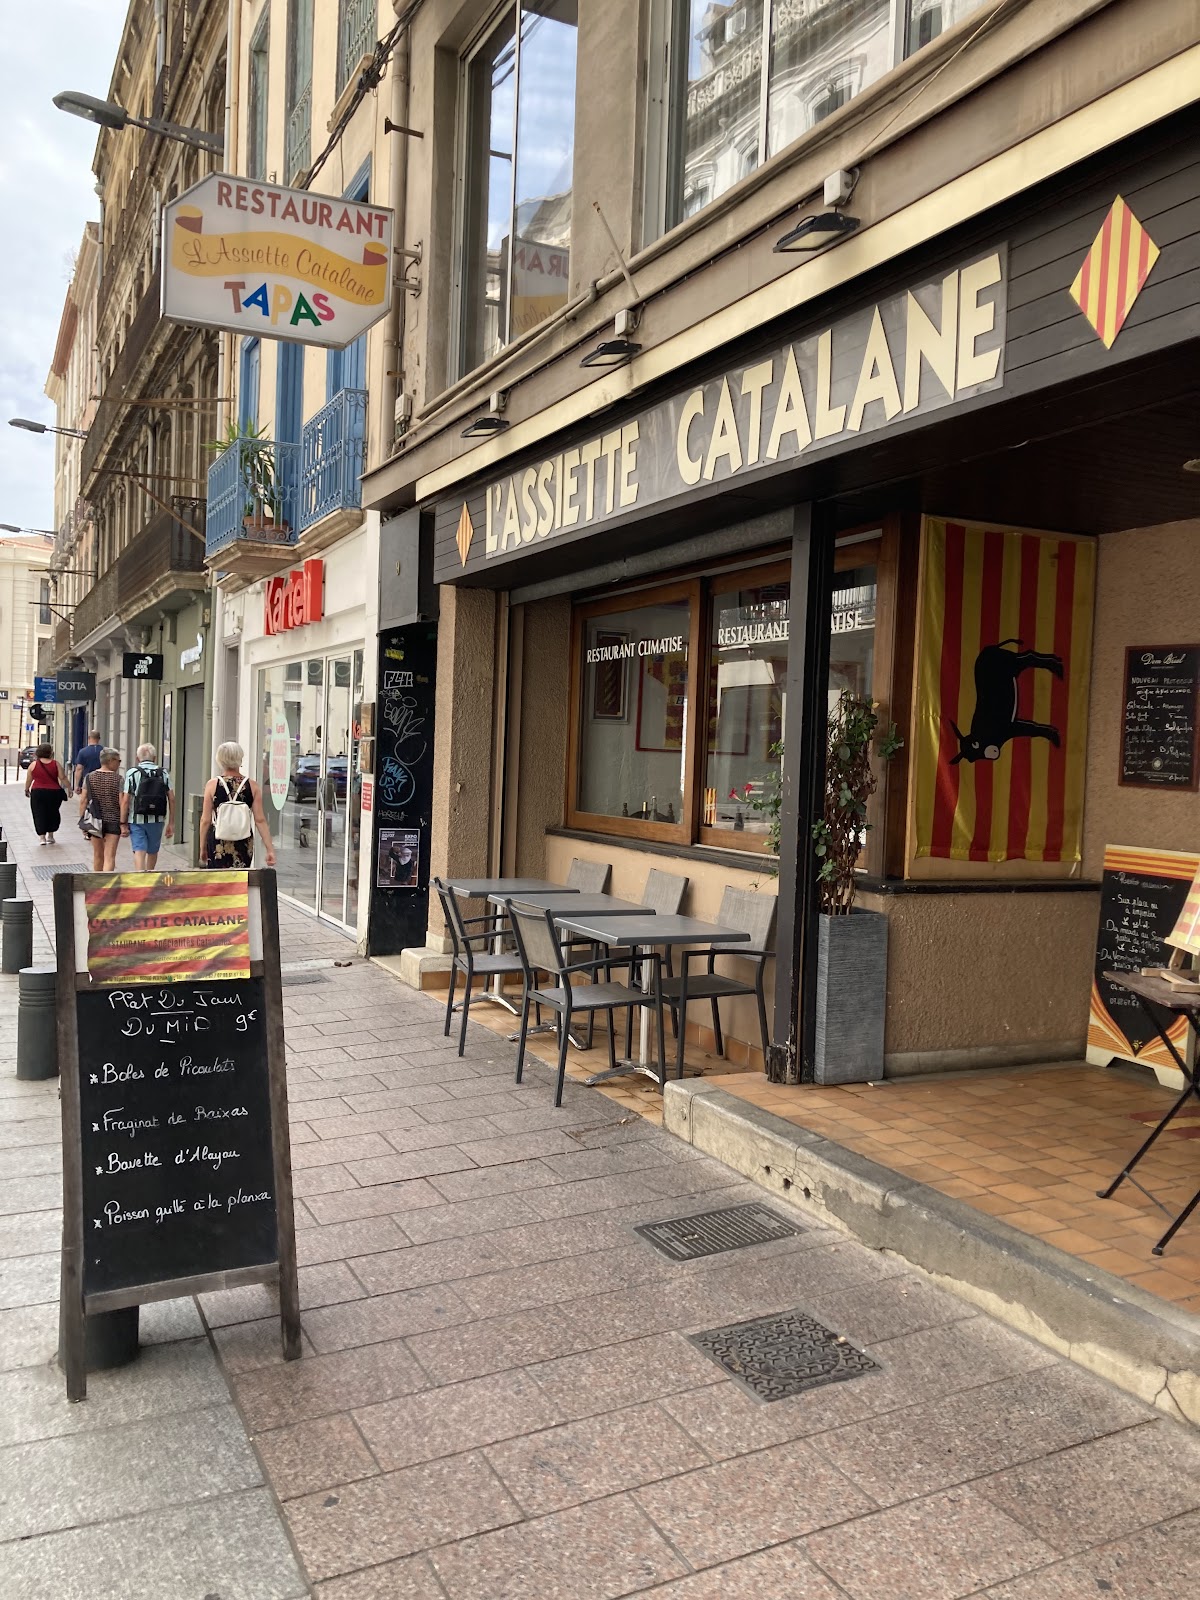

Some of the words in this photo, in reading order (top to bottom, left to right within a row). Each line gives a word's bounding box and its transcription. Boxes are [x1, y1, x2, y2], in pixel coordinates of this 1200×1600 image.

[217, 180, 388, 239] RESTAURANT
[296, 248, 375, 303] Catalane
[224, 281, 335, 327] TAPAS
[485, 420, 641, 555] L'ASSIETTE
[676, 252, 1002, 486] CATALANE
[264, 560, 318, 636] Kartell
[718, 620, 790, 645] RESTAURANT
[587, 643, 635, 663] RESTAURANT
[638, 636, 683, 656] CLIMATISE
[58, 681, 87, 691] ISOTTA
[173, 914, 244, 927] CATALANE
[108, 990, 153, 1010] Plat
[157, 989, 184, 1009] Du
[120, 1016, 155, 1036] Du
[154, 1061, 170, 1079] de
[167, 1111, 187, 1125] de
[106, 1151, 162, 1174] Bavette
[104, 1200, 150, 1225] Poisson
[208, 1193, 222, 1209] la
[227, 1188, 272, 1213] planxa
